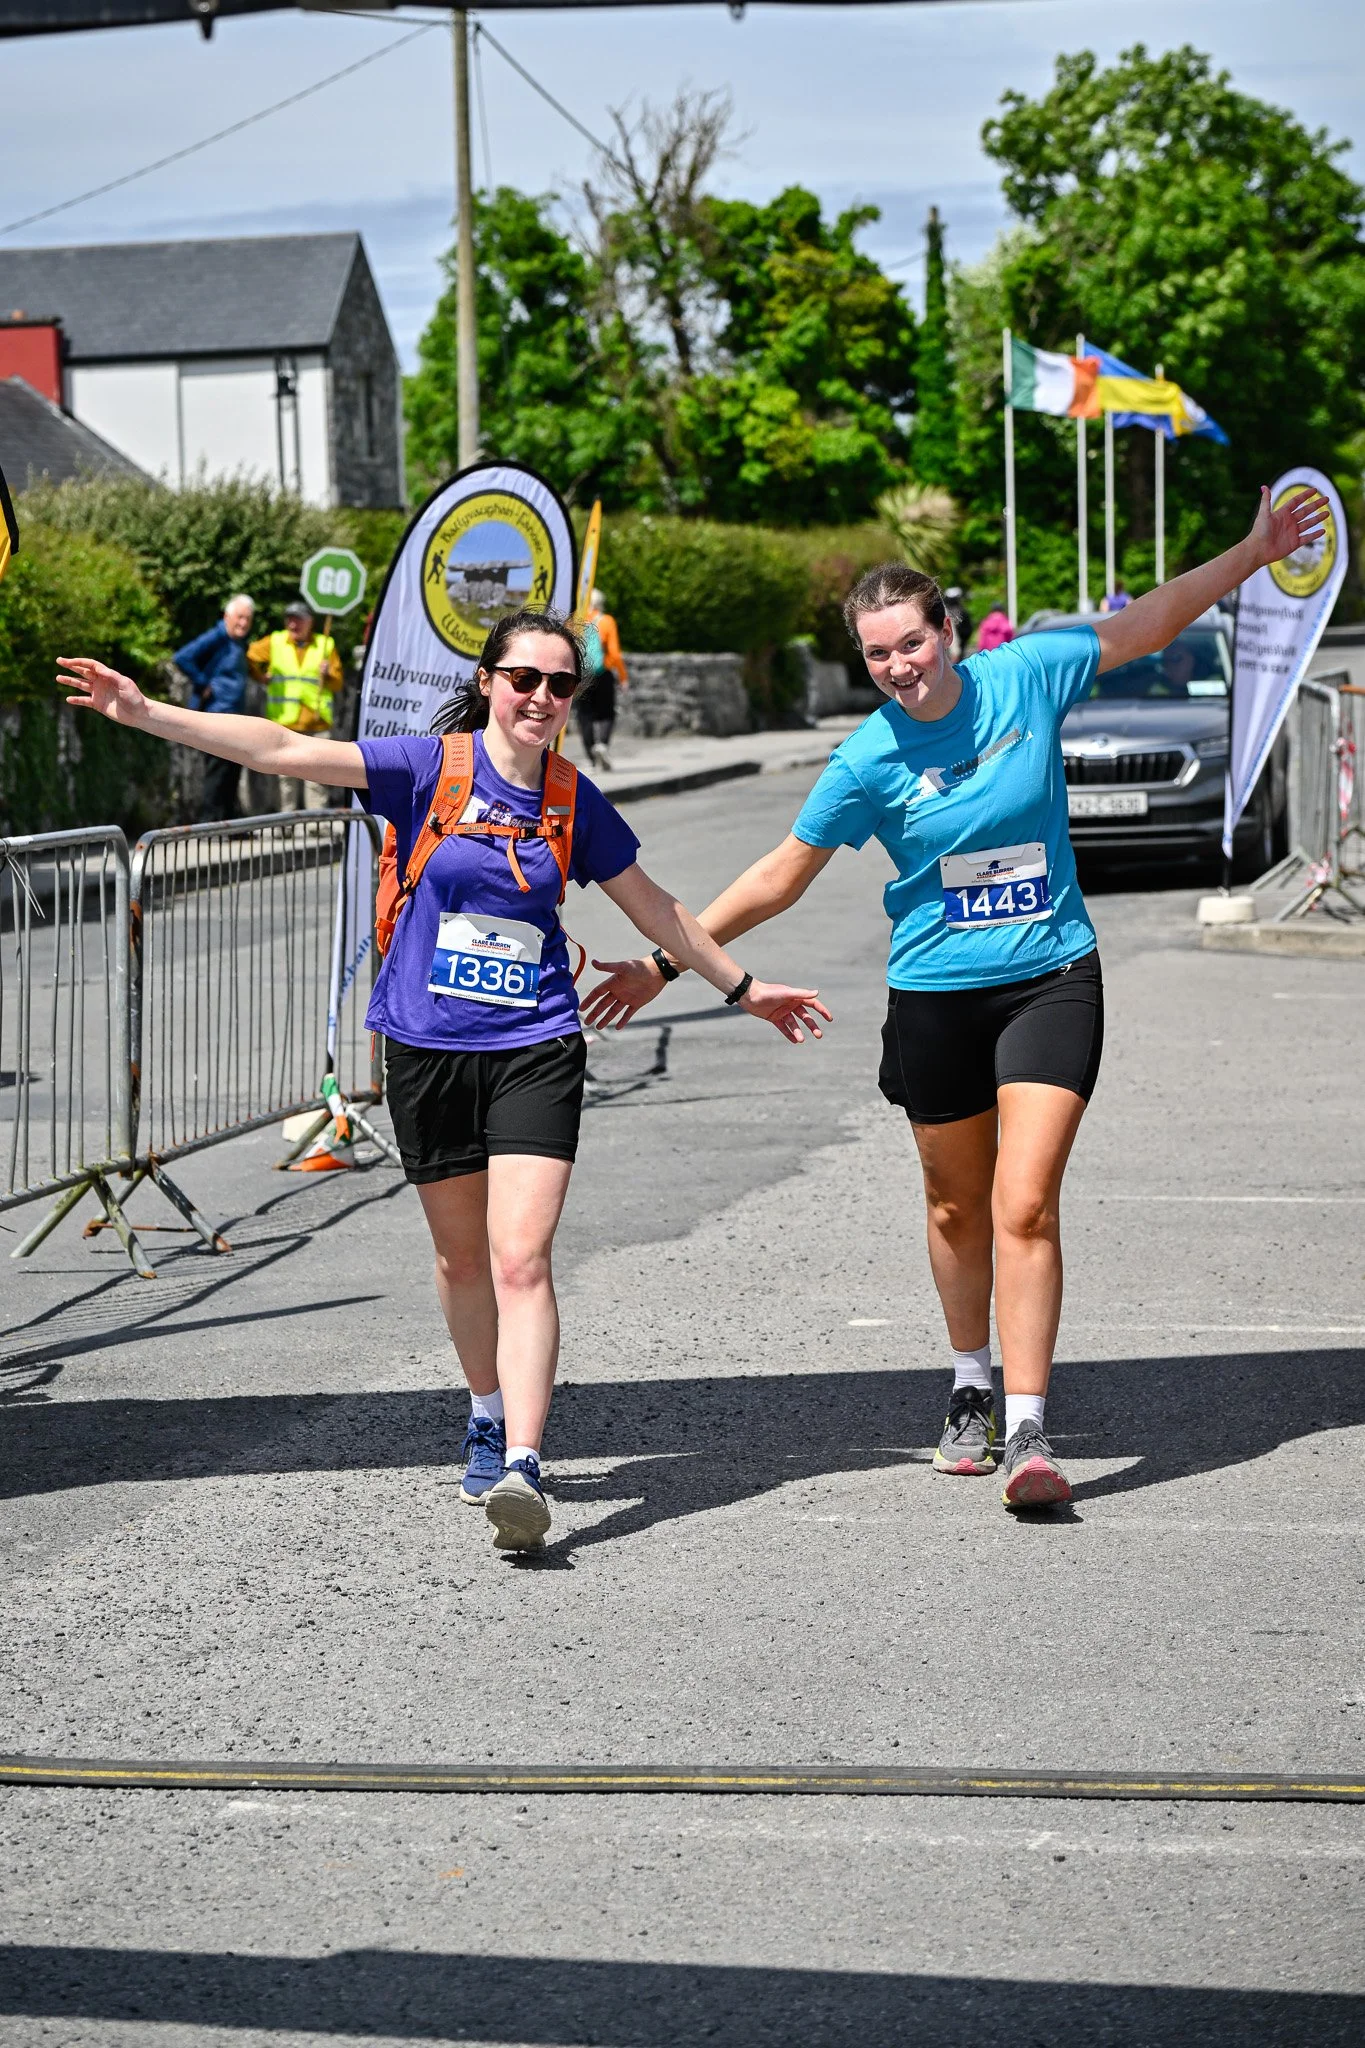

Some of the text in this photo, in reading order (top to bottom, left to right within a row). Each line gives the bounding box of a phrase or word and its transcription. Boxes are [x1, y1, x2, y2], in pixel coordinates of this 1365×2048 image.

[316, 565, 353, 597] GO
[957, 882, 1038, 918] 1443
[447, 954, 525, 994] 1336
